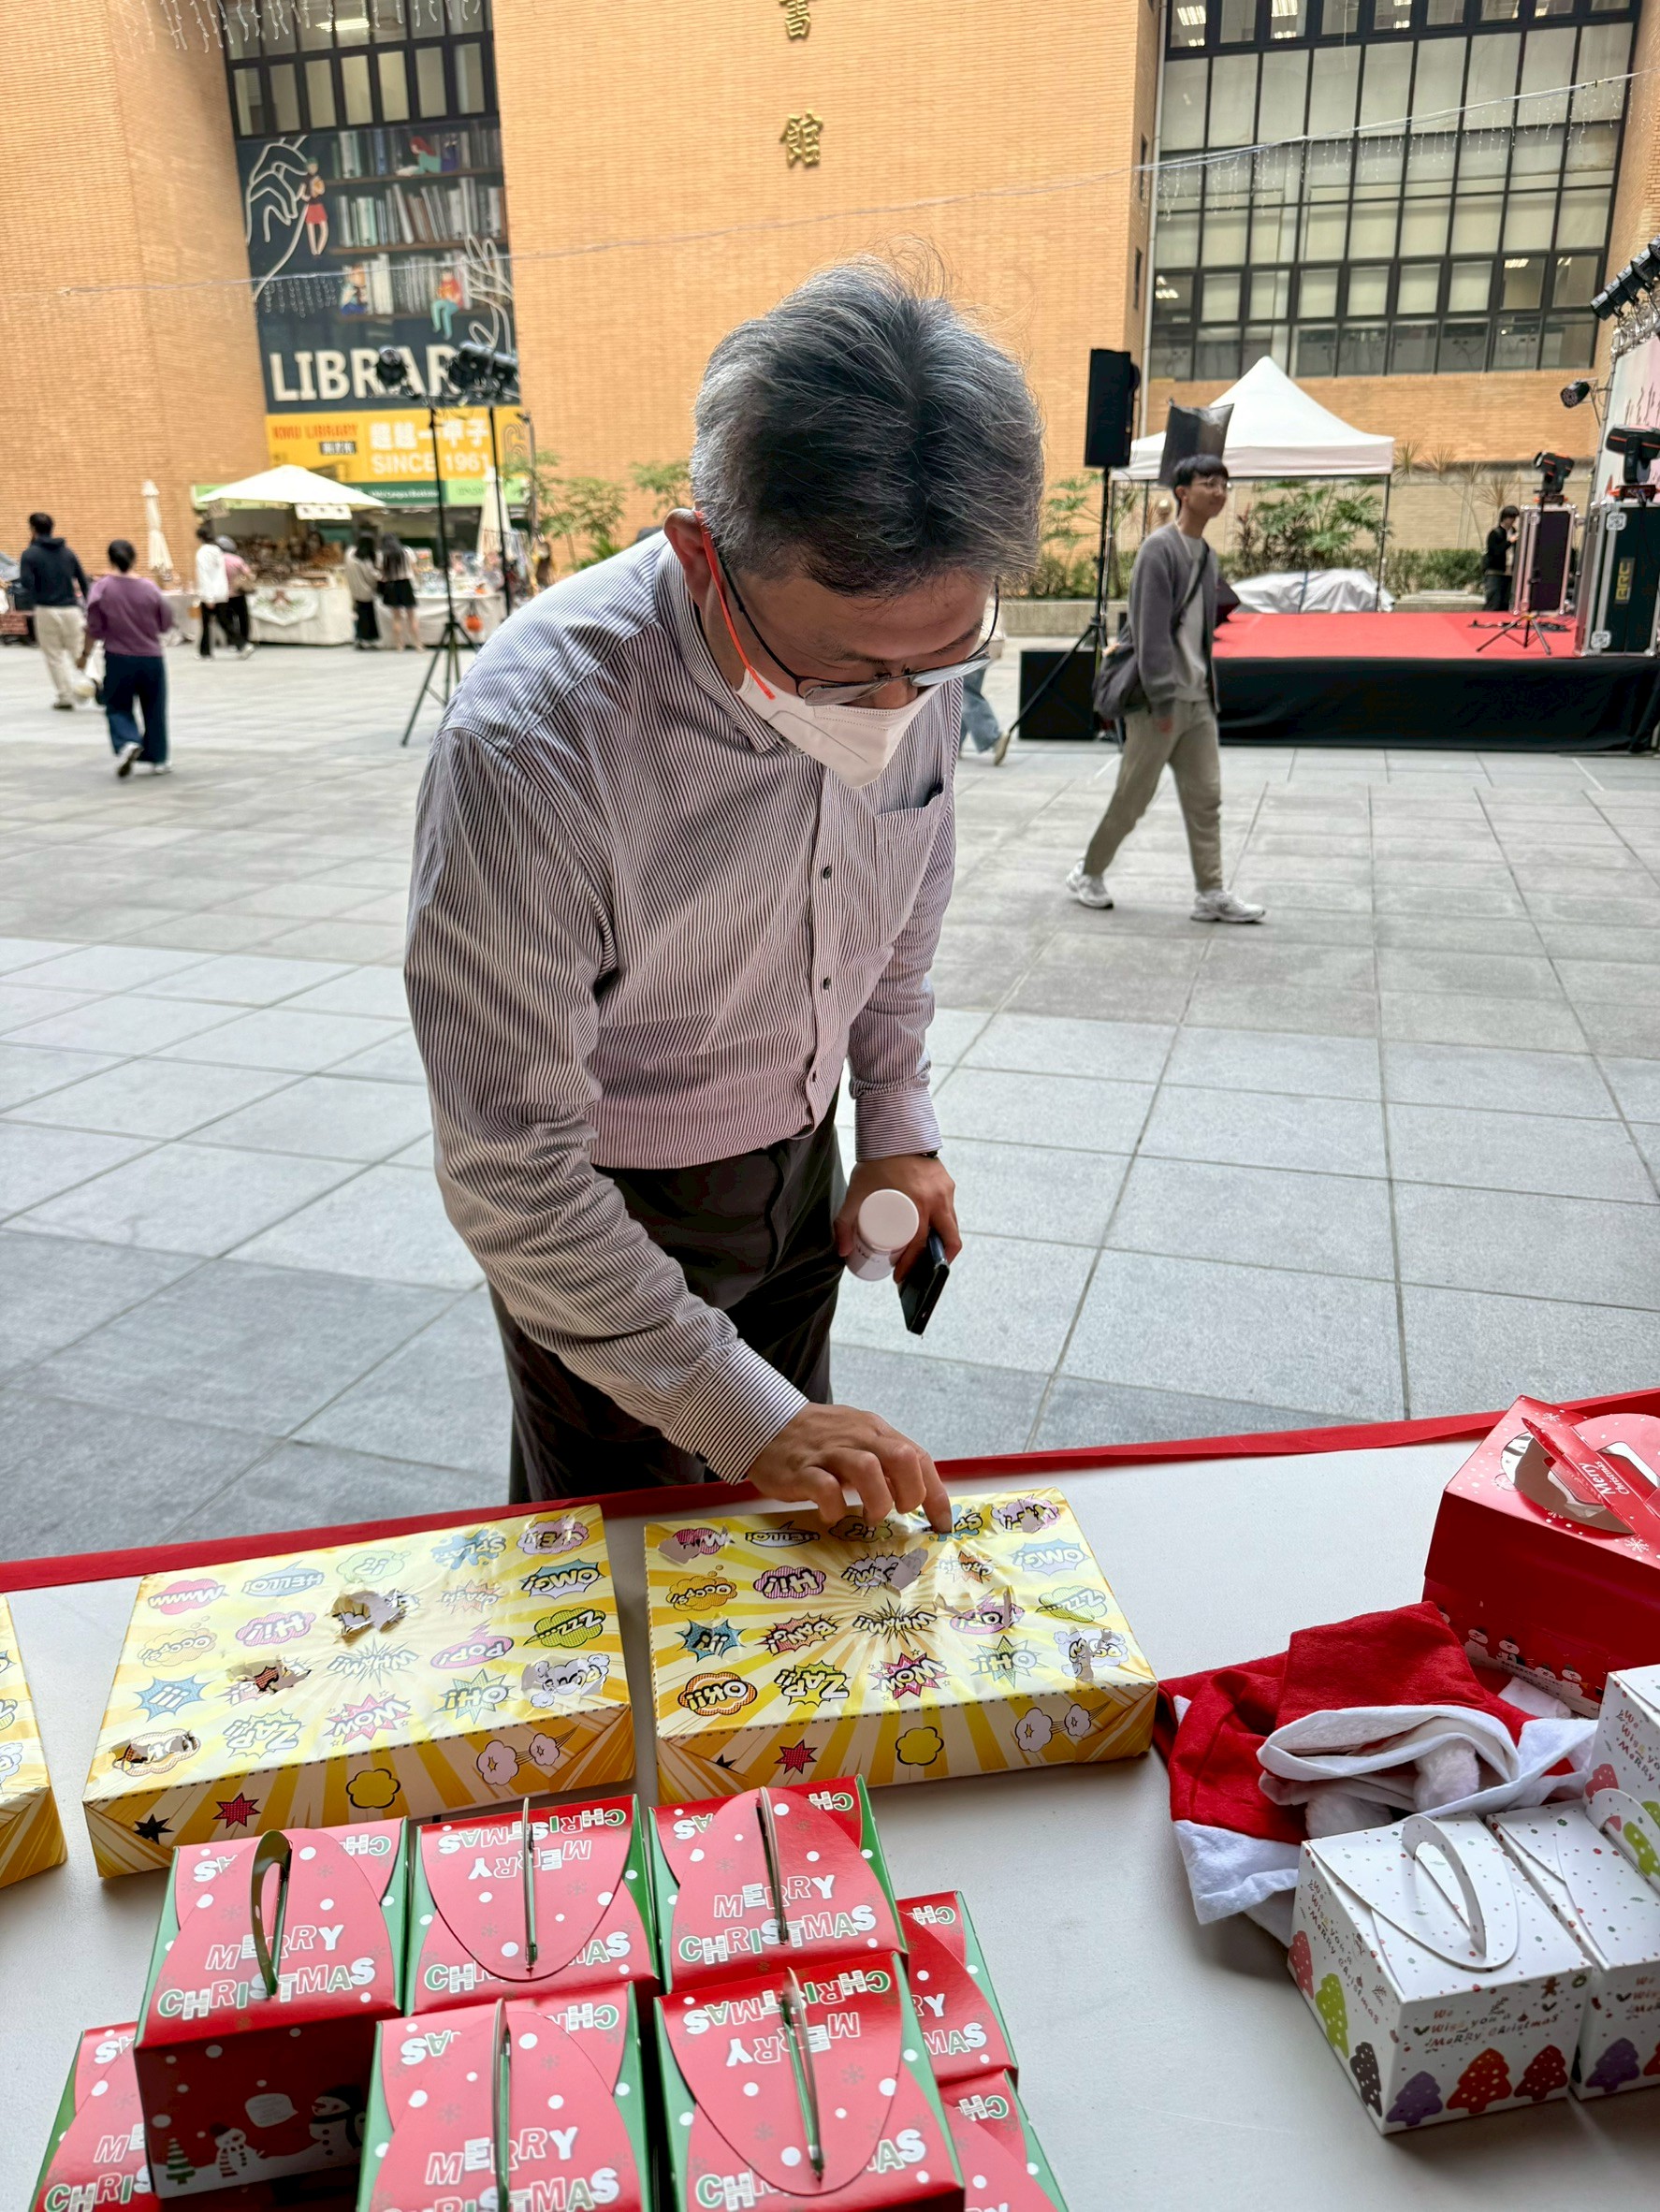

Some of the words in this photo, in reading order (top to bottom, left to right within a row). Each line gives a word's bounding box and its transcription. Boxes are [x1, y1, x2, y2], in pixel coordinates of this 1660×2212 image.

[269, 344, 468, 402] LIBRAR
[371, 454, 435, 474] SINCE
[444, 451, 493, 473] 1961
[1579, 1463, 1616, 1495] Merry
[1594, 1461, 1630, 1495] Christmas
[937, 1560, 994, 1577] CRASH
[1013, 1548, 1083, 1568] OMG!
[241, 1573, 324, 1594] HELLO!
[520, 1568, 599, 1593] OMG!
[763, 1569, 819, 1597] Hi!
[243, 1612, 306, 1641] Hi!
[766, 1621, 837, 1654] BANG!
[852, 1612, 937, 1635] WHAM!!
[326, 1651, 417, 1676] WHAM!!
[437, 1643, 504, 1665] POP!
[977, 1649, 1038, 1672] OH!
[773, 1668, 849, 1699] ZAP!!
[879, 1659, 946, 1693] WOW
[444, 1685, 509, 1709] OH!
[686, 1683, 748, 1710] OK!!
[332, 1701, 409, 1737] WOW
[223, 1719, 299, 1752] ZAP!!
[438, 1808, 626, 1855] CHRISTMAS
[468, 1840, 592, 1880] MERRY
[714, 1874, 835, 1918] MERRY
[205, 1925, 344, 1971] MERRY
[678, 1904, 877, 1965] CHRISTMAS
[157, 1957, 376, 2021] CHRISTMAS
[425, 2126, 578, 2186] MERRY
[44, 2164, 153, 2212] CHRIS
[382, 2166, 620, 2212] RISTMAS
